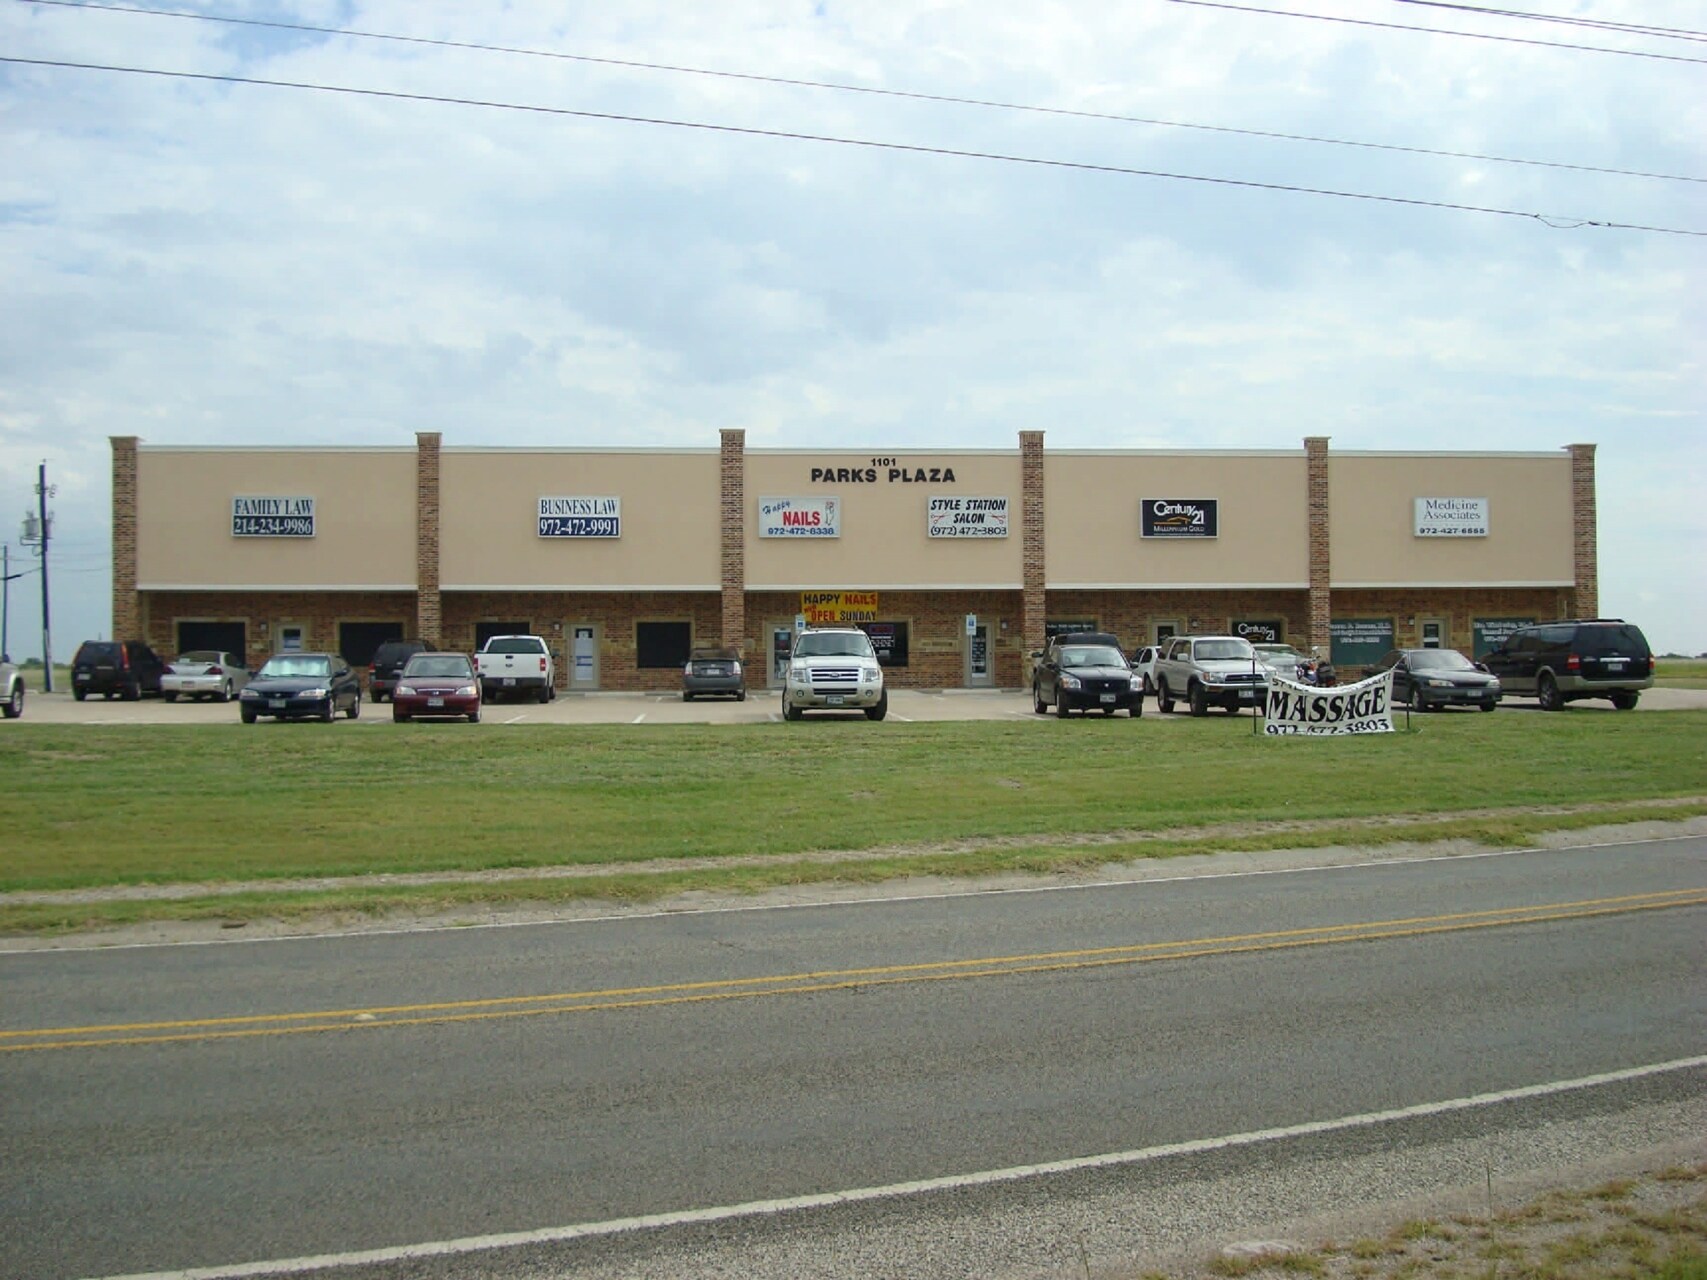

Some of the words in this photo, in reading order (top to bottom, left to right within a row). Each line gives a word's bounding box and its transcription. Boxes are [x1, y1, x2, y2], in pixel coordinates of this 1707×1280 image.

[871, 458, 896, 467] 1101
[811, 468, 877, 483] PARKS
[889, 468, 956, 483] PLAZA
[235, 499, 281, 515] FAMILY
[285, 499, 313, 515] LAW
[541, 499, 591, 515] BUSINESS
[594, 499, 617, 515] LAW
[762, 500, 791, 515] Happy
[930, 499, 961, 511] STYLE
[965, 499, 1006, 511] STATION
[1426, 499, 1478, 510] Medicine
[782, 511, 821, 526] NAILS
[953, 513, 985, 523] SALON
[1153, 500, 1196, 516] Century
[1192, 510, 1205, 525] 21
[1424, 511, 1481, 520] Associates
[234, 518, 312, 533] 214-234-9986
[540, 519, 617, 535] 972-472-9991
[930, 526, 957, 536] (972)
[959, 527, 1007, 535] 472-3803
[804, 593, 840, 605] HAPPY
[844, 593, 877, 605] NAILS
[811, 610, 835, 621] OPEN
[840, 610, 876, 621] SUNDAY
[1268, 686, 1386, 722] MASSAGE
